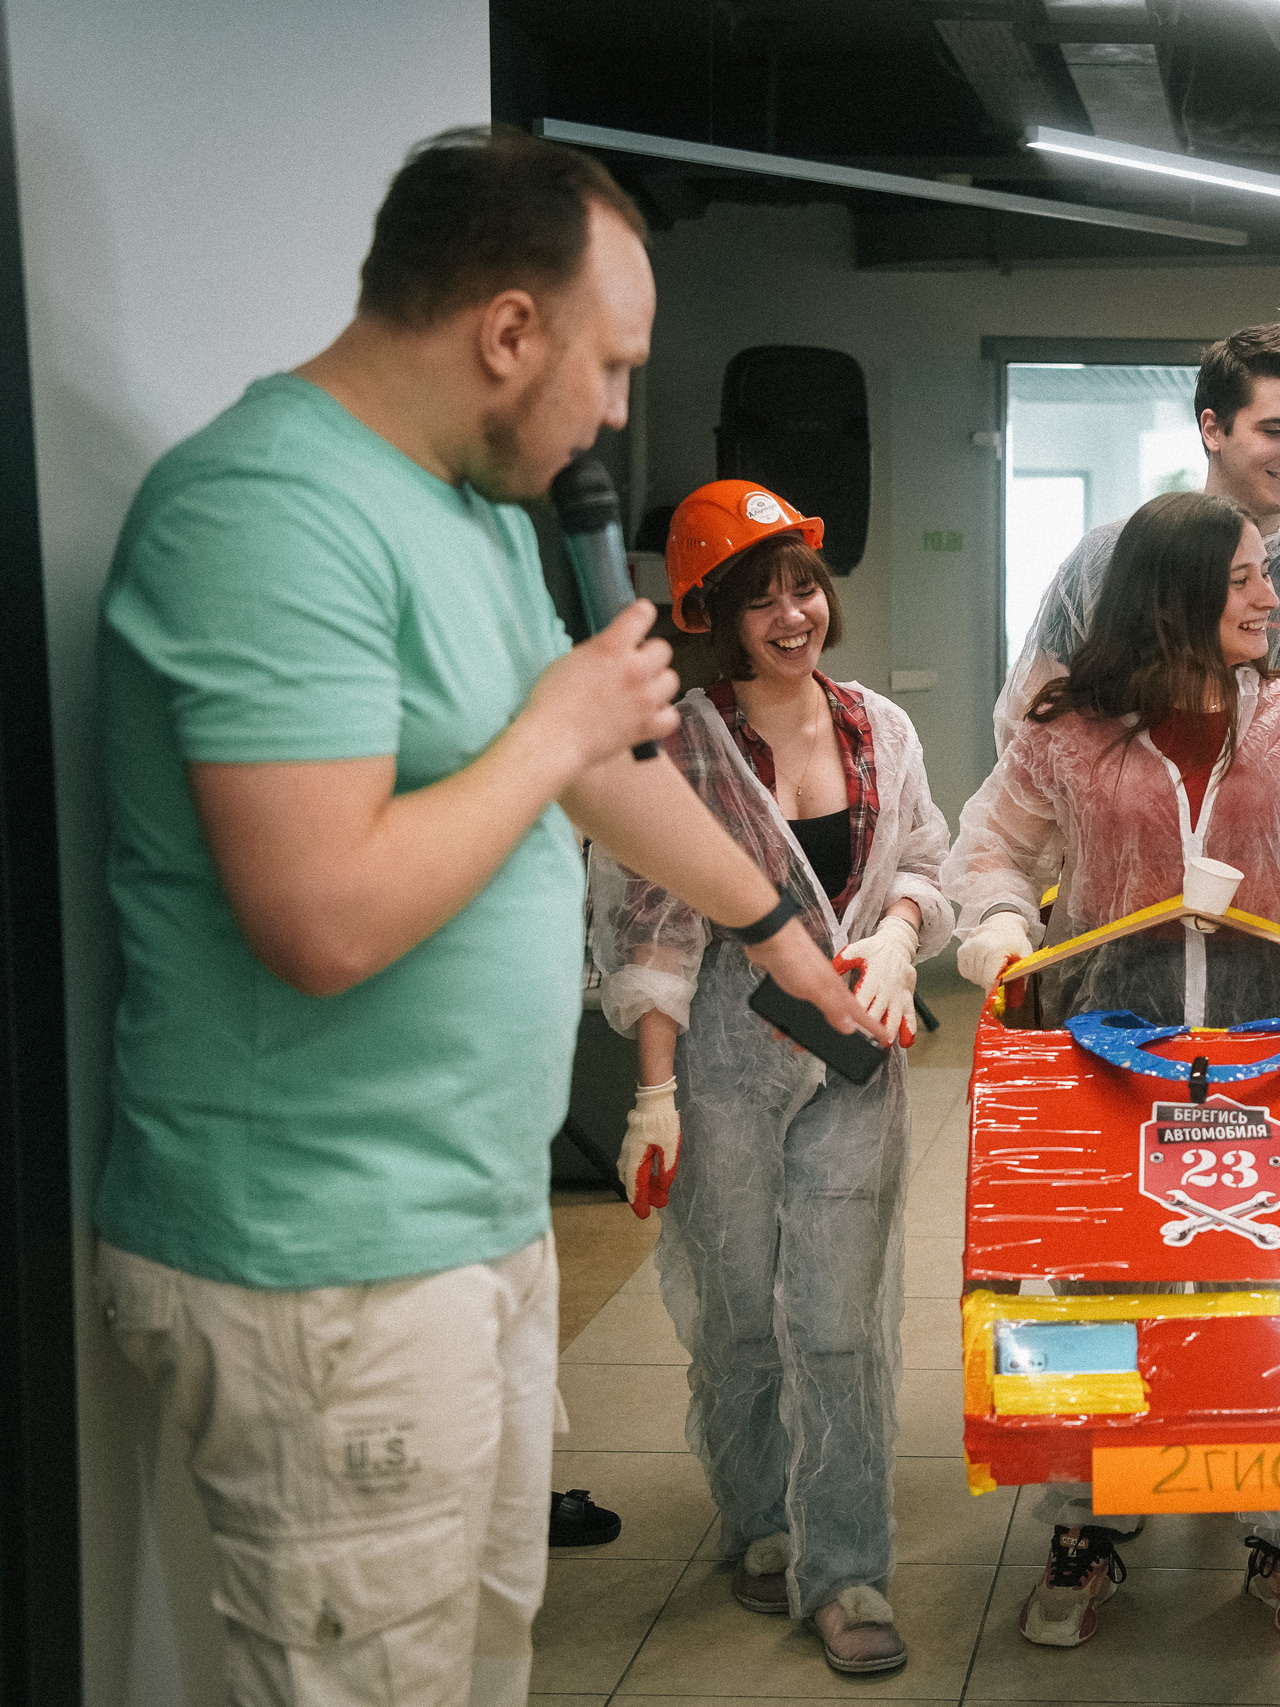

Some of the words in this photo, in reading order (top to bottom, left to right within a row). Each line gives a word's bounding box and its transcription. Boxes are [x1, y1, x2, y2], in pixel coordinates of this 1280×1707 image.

[1173, 1108, 1248, 1125] БЕРЕГИСЬ
[1164, 1124, 1267, 1142] АВТОМОБИЛЯ
[1181, 1149, 1259, 1188] 23
